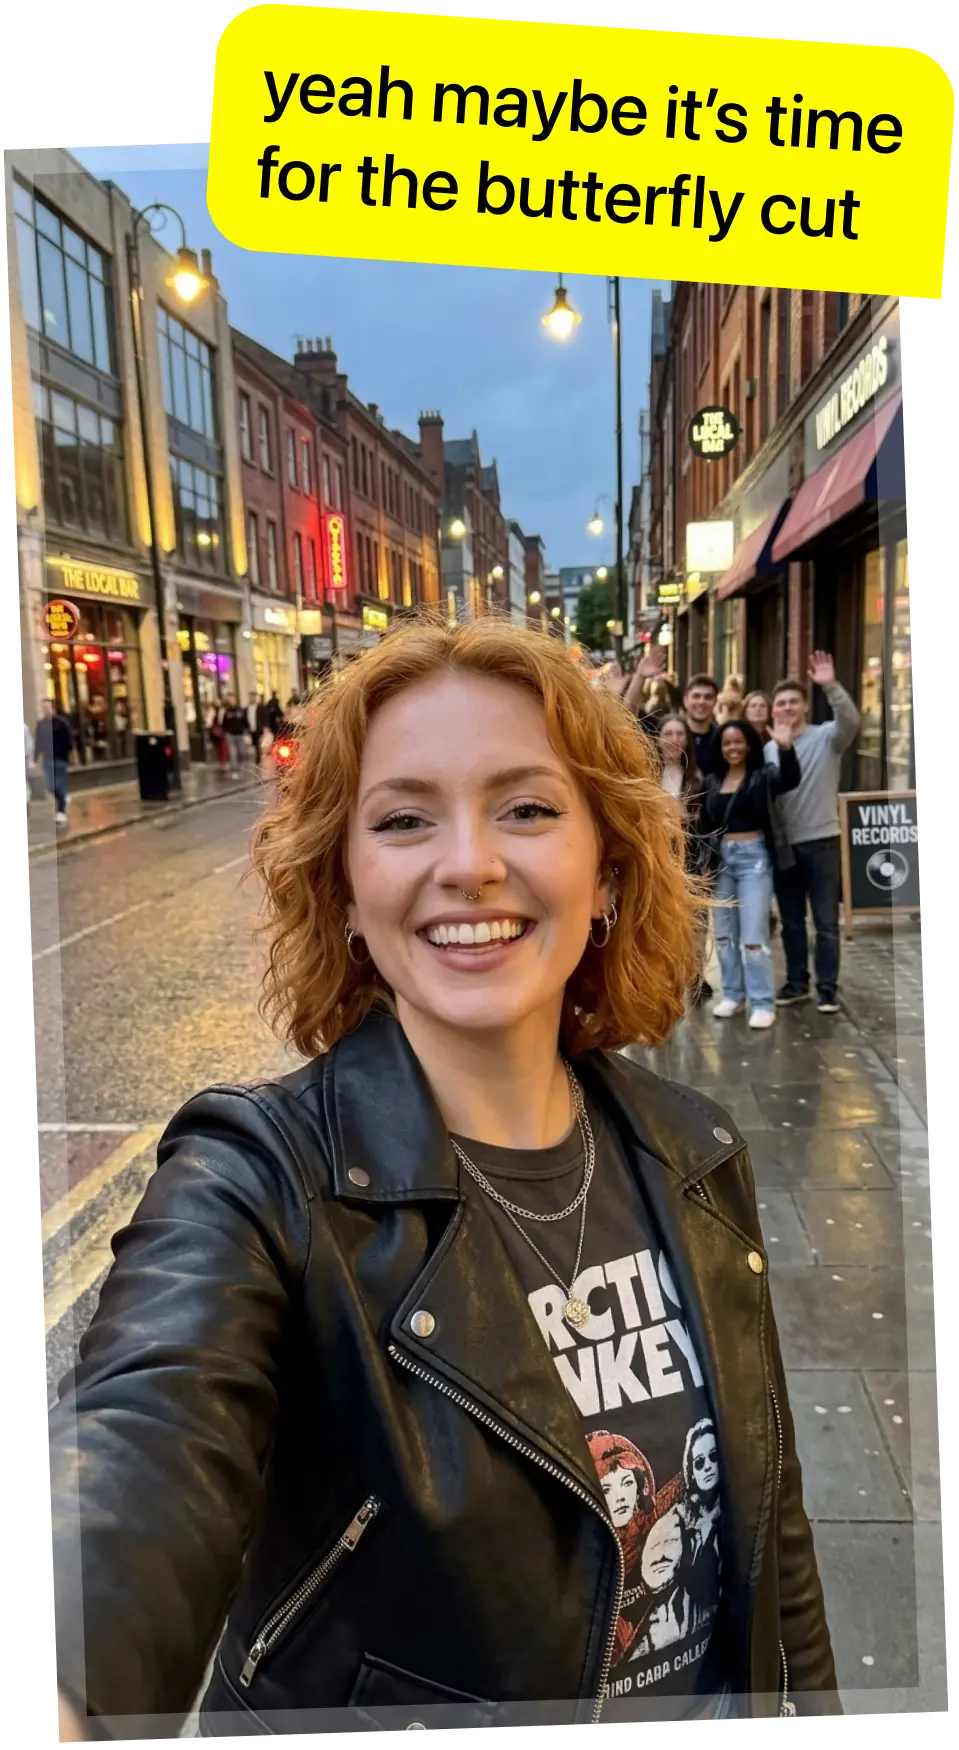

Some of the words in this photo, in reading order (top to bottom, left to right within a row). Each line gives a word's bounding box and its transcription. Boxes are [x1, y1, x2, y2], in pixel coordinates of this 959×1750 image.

[702, 411, 725, 425] THE
[61, 566, 85, 591] THE
[84, 570, 120, 597] LOCAL
[858, 803, 913, 826] VINYL
[851, 824, 919, 846] RECORDS
